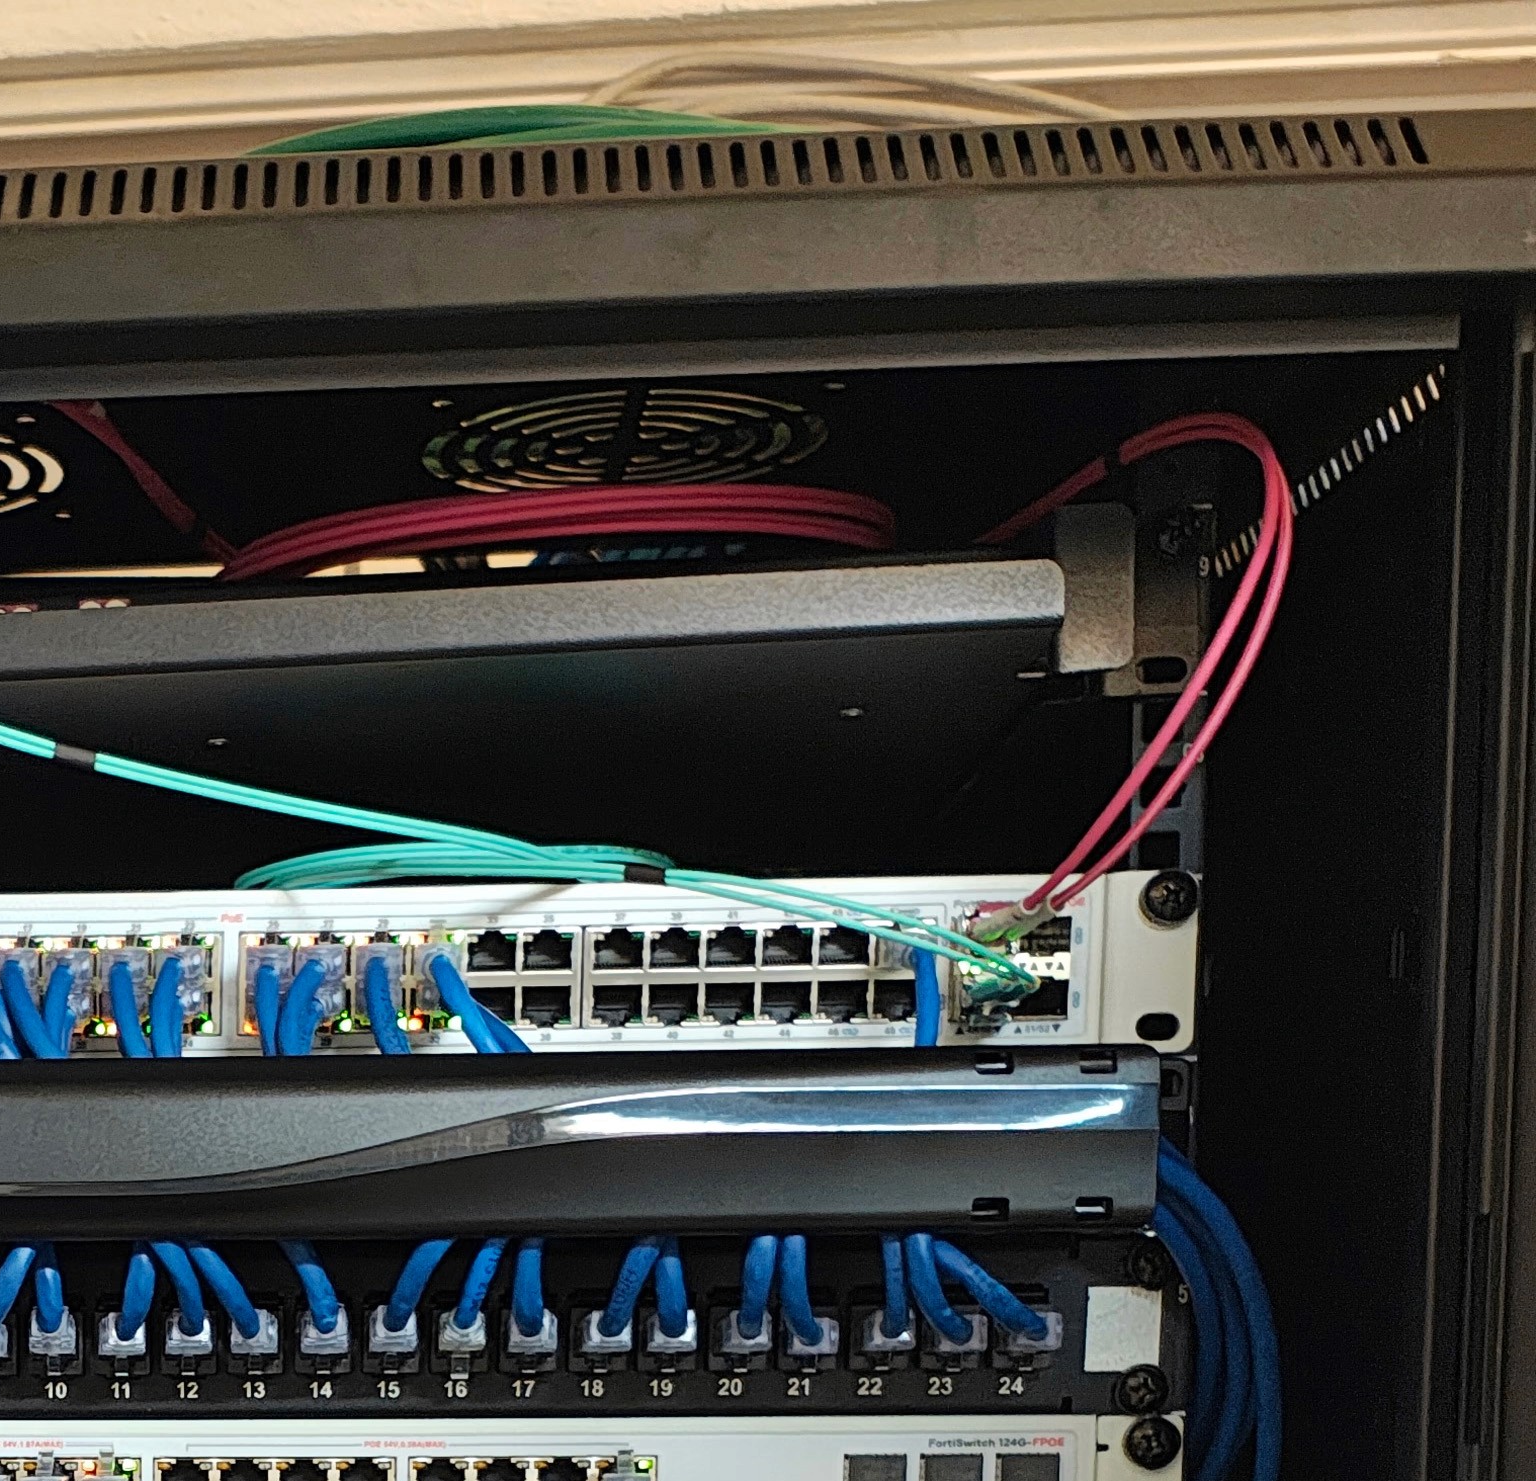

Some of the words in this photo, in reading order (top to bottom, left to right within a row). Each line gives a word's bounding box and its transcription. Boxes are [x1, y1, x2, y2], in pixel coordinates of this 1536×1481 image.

[44, 1381, 68, 1399] 10
[111, 1382, 130, 1399] 11
[176, 1381, 199, 1399] 12
[242, 1381, 266, 1399] 13
[309, 1381, 333, 1399] 14
[377, 1380, 401, 1399] 15
[443, 1380, 469, 1399] 16
[512, 1379, 536, 1398] 17
[580, 1379, 604, 1397] 18
[649, 1379, 673, 1397] 19
[718, 1378, 743, 1396] 20
[787, 1377, 810, 1396] 21
[857, 1377, 883, 1396] 22
[928, 1376, 953, 1395] 23
[998, 1376, 1024, 1395] 24
[928, 1437, 995, 1448] FortiSwitch
[999, 1436, 1065, 1448] 124G-FPOE
